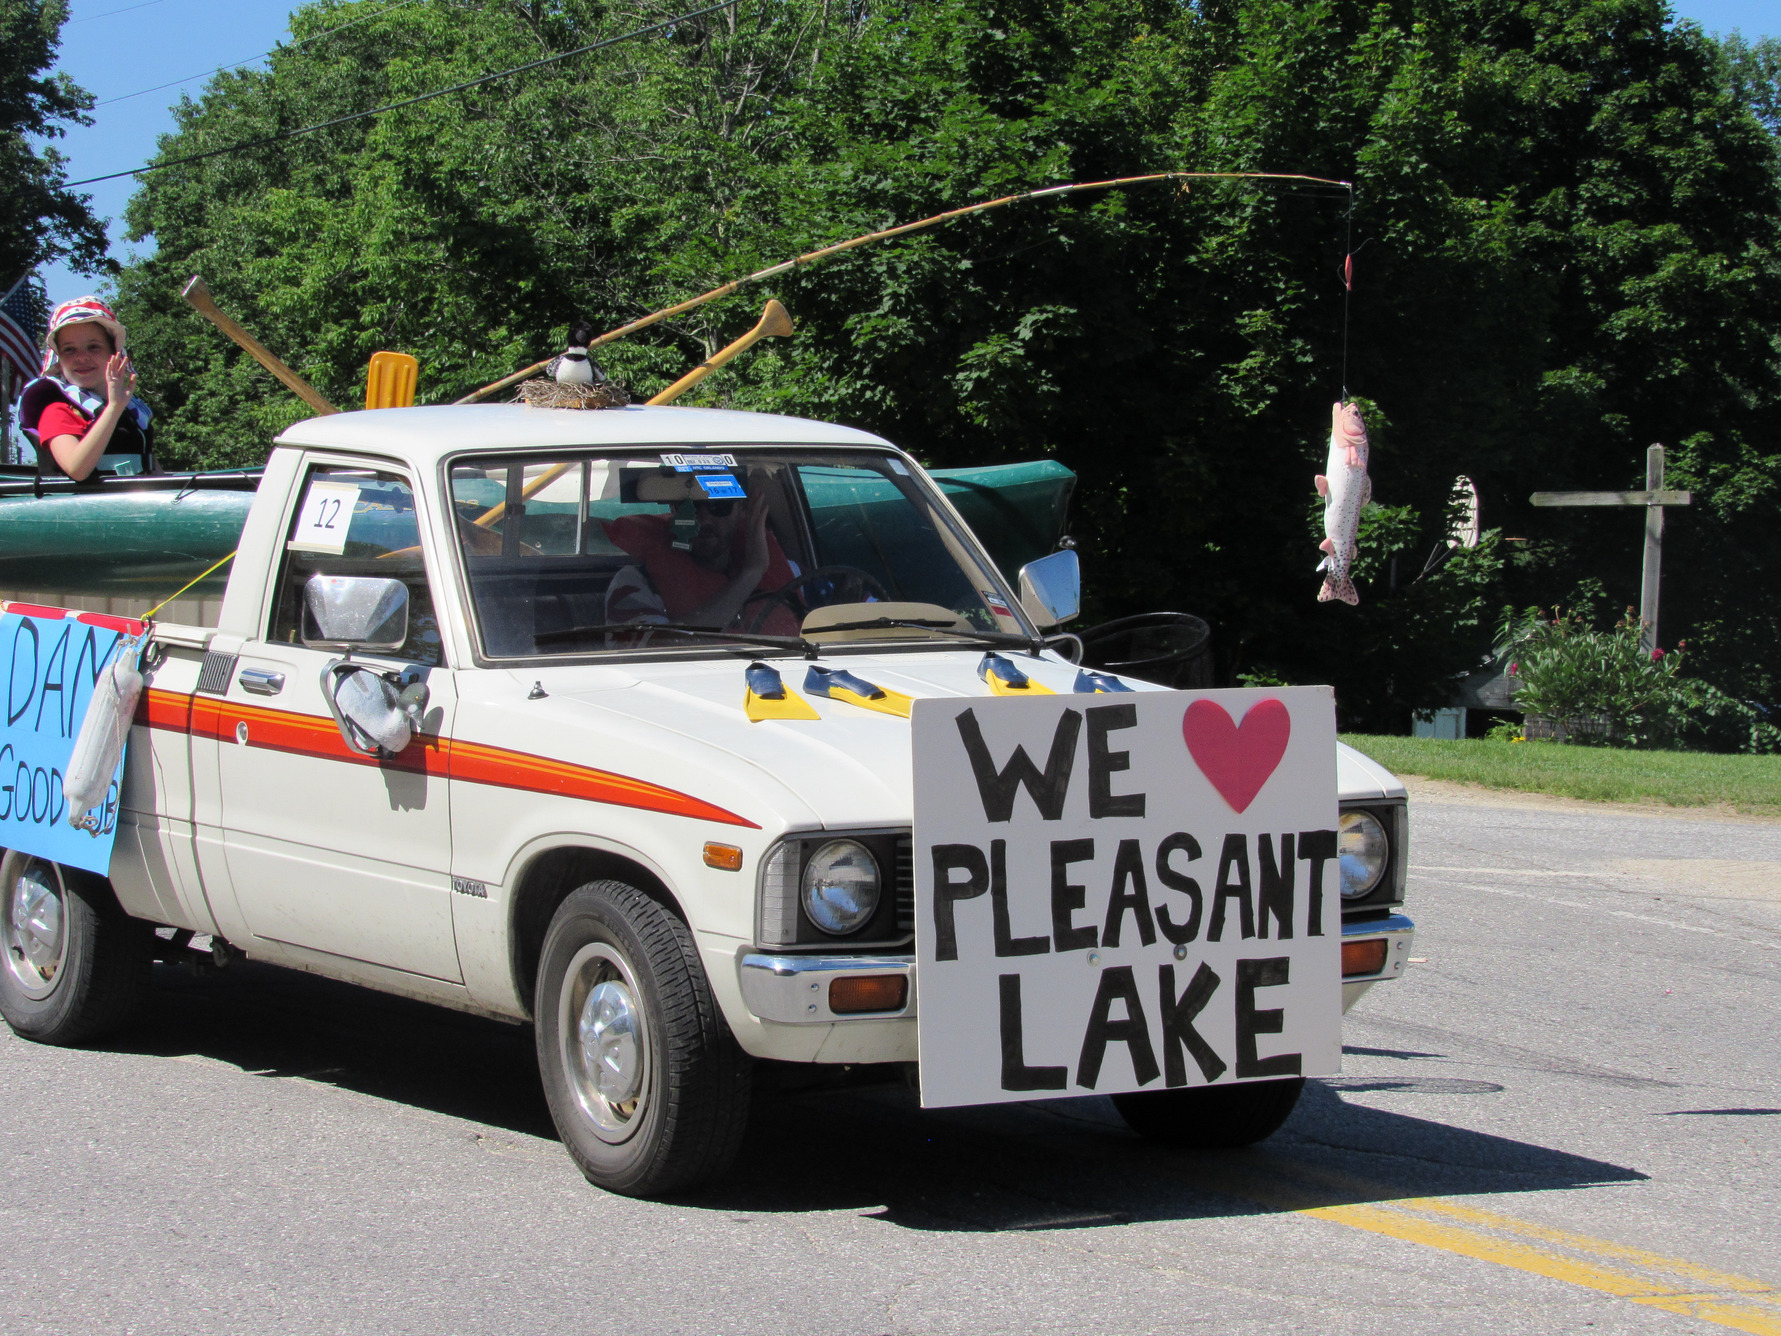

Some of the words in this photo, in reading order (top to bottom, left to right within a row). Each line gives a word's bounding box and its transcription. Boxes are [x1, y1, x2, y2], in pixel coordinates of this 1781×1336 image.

[313, 498, 341, 529] 12
[0, 743, 65, 828] GOOD
[954, 703, 1146, 823] WE
[451, 878, 488, 899] TOYOTA
[931, 830, 1338, 962] PLEASANT
[999, 957, 1302, 1091] LAKE
